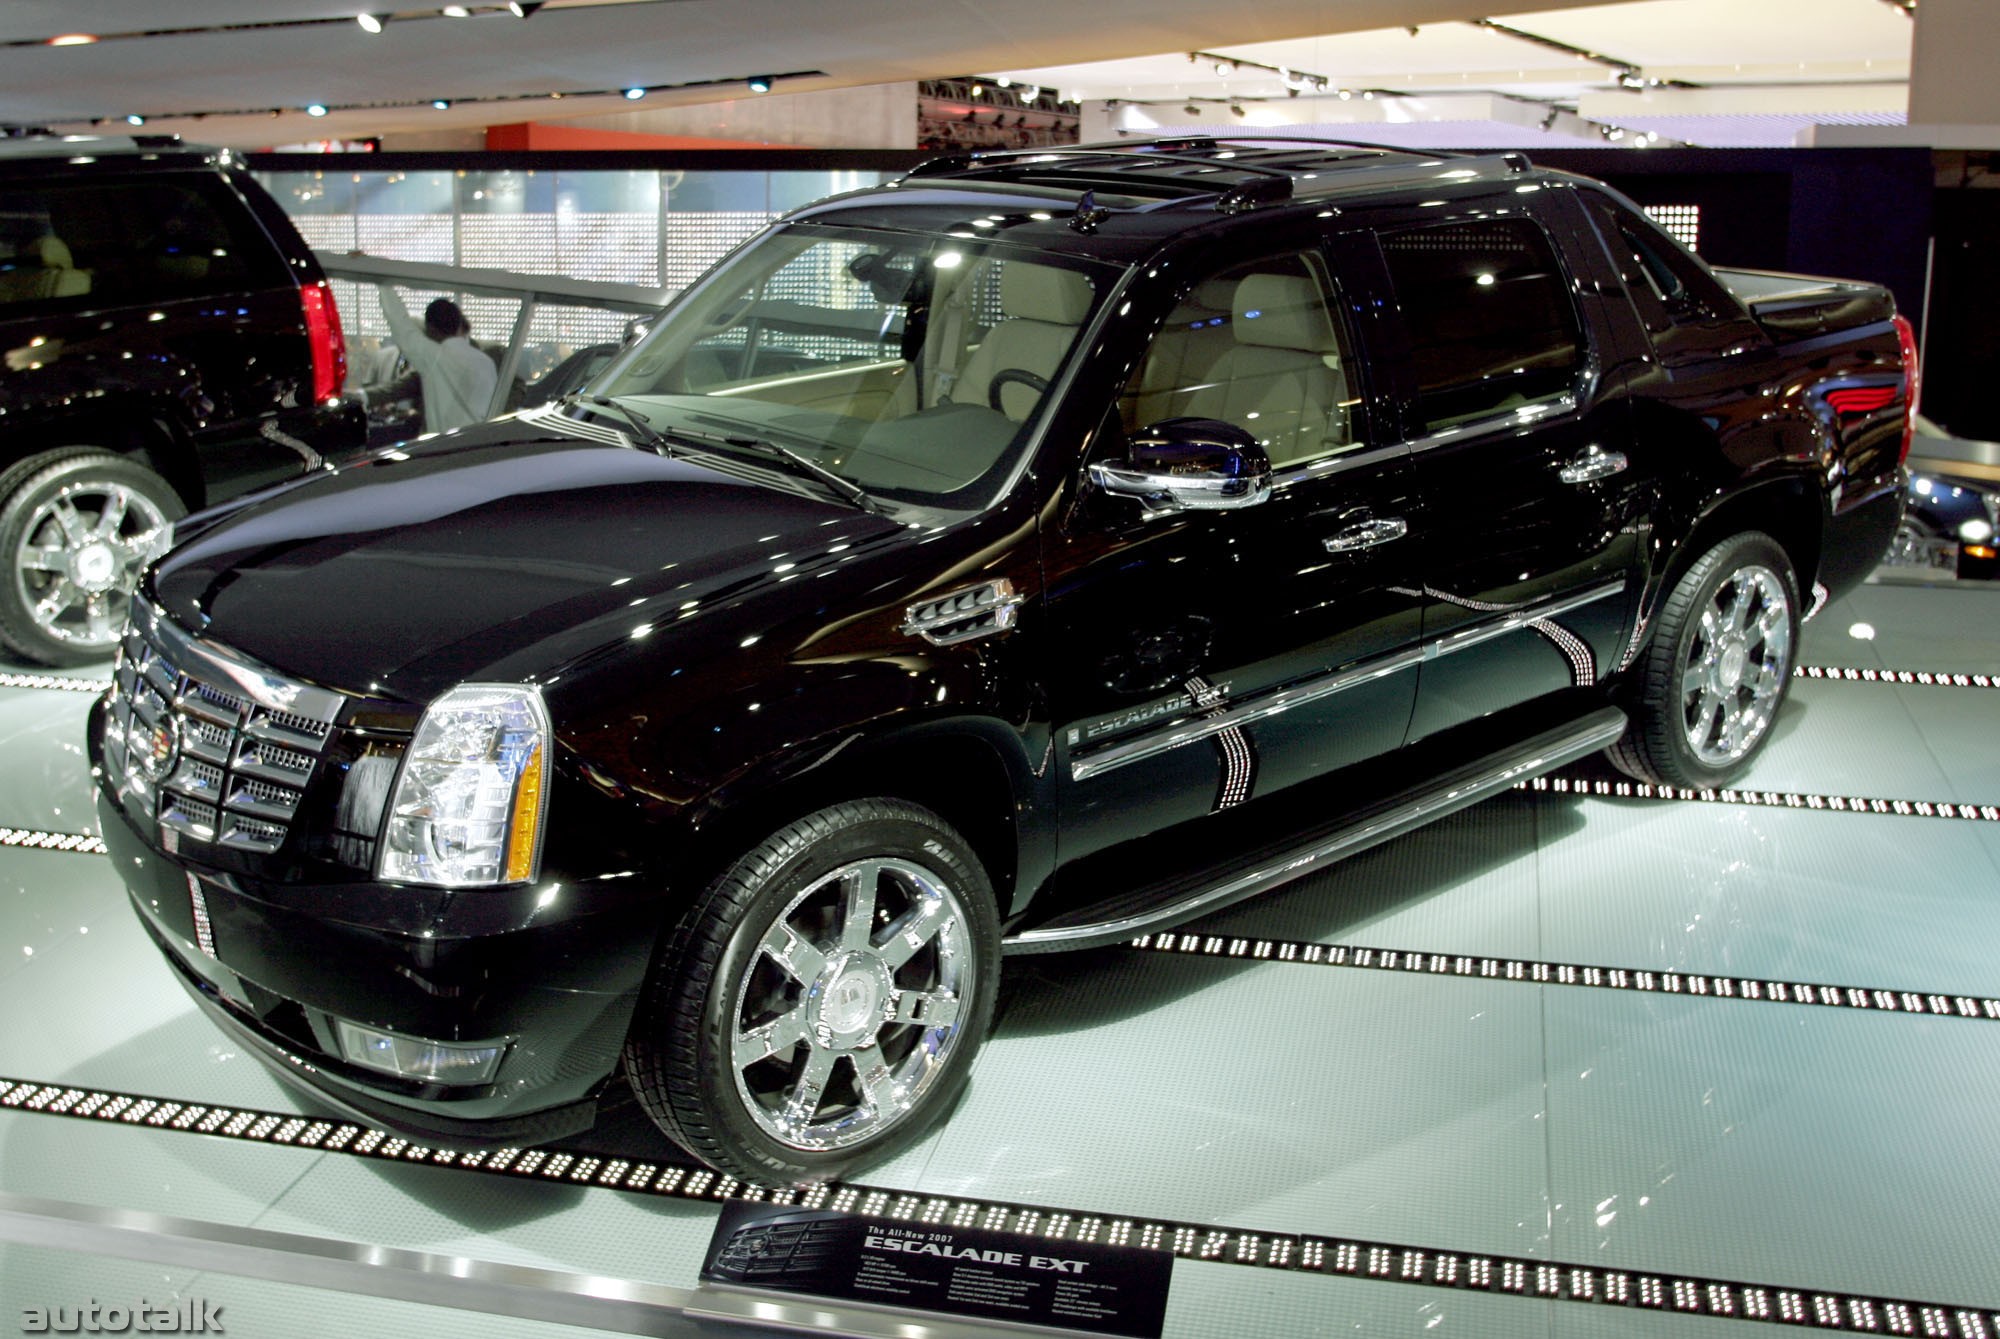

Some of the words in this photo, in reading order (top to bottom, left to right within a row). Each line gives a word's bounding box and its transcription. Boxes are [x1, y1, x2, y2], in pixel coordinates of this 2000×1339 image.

[868, 1226, 885, 1235] The
[888, 1228, 925, 1240] All-New
[928, 1233, 953, 1243] 2007
[864, 1235, 1023, 1267] ESCALADE
[1028, 1256, 1090, 1275] EXT
